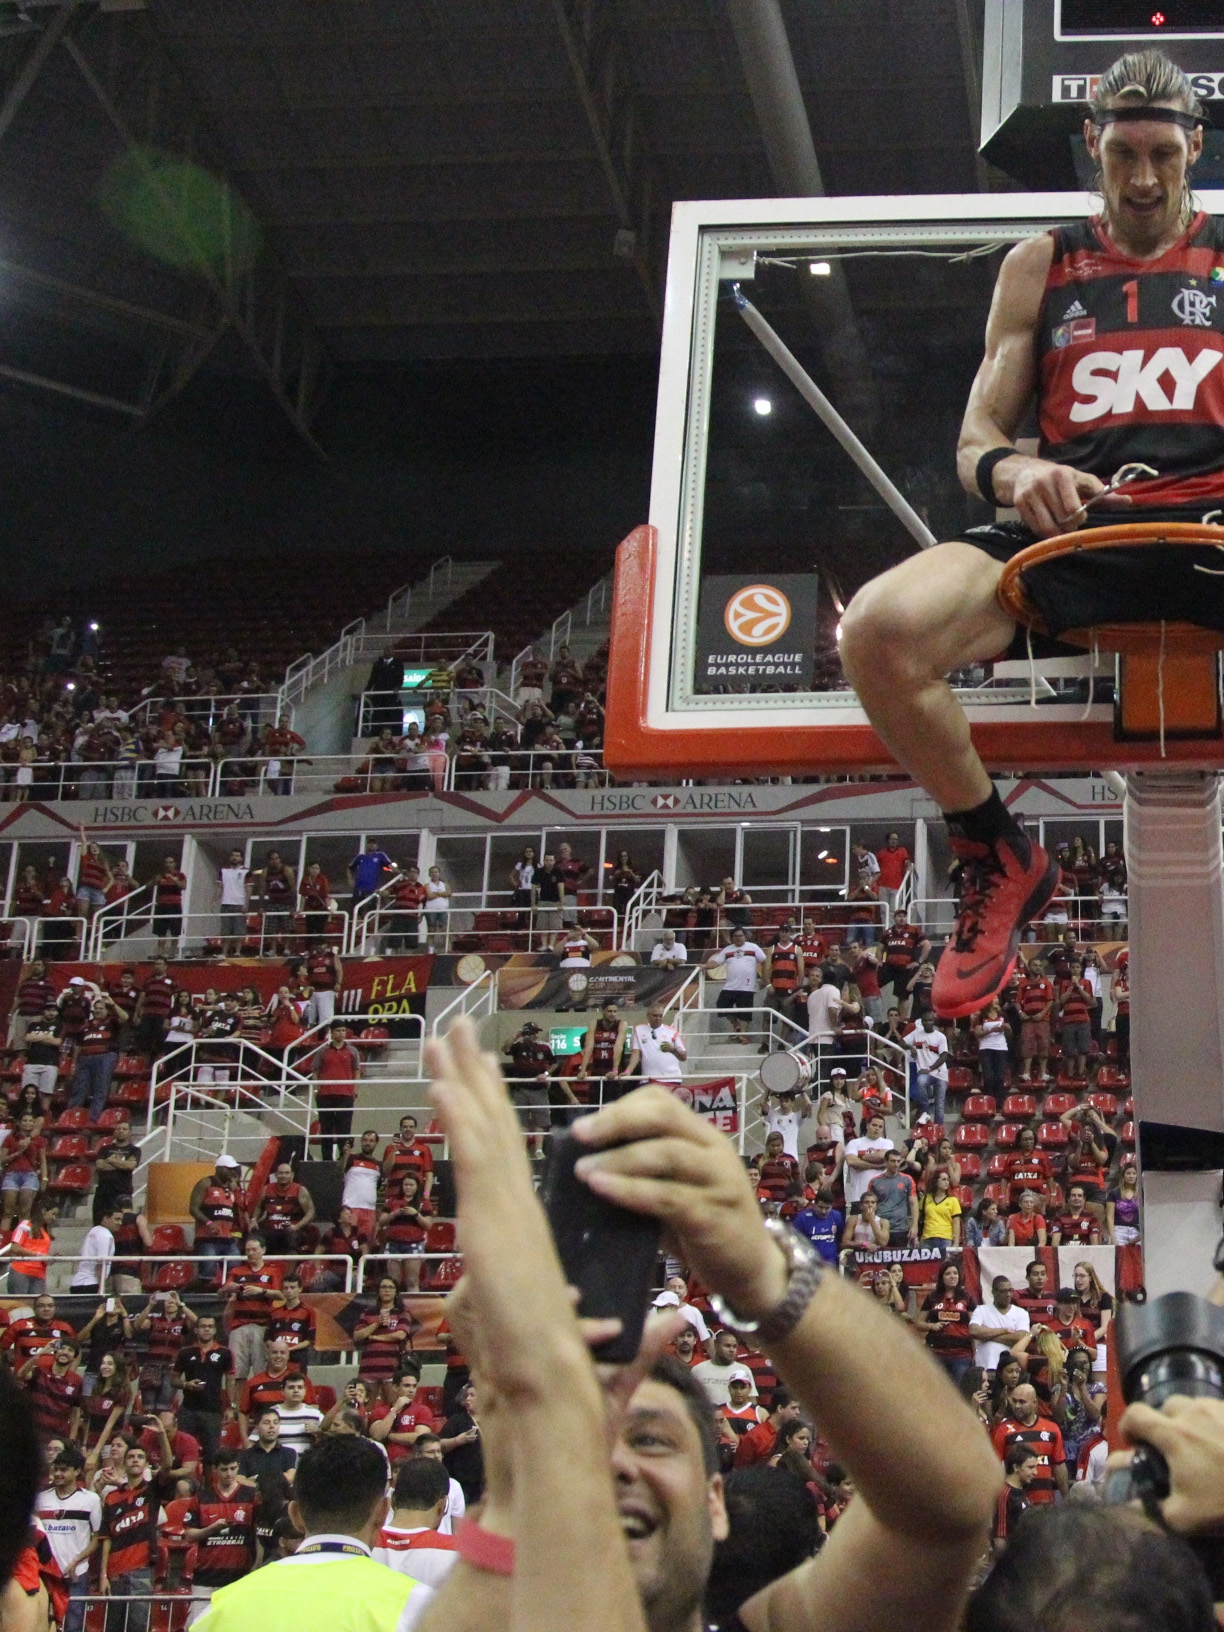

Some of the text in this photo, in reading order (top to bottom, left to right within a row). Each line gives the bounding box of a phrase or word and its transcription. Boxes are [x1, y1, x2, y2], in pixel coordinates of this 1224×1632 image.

[1122, 280, 1138, 324] 1
[1069, 346, 1224, 424] SKY
[707, 653, 804, 665] EUROLEAGUE
[706, 665, 803, 676] BASKETBALL
[590, 792, 757, 812] HSBC ARENA
[93, 803, 255, 825] HSBC ARENA
[371, 970, 418, 1000] FLA
[588, 975, 636, 983] CONTINENTAL
[550, 1039, 567, 1050] 116
[855, 1247, 942, 1264] URUBUZADA
